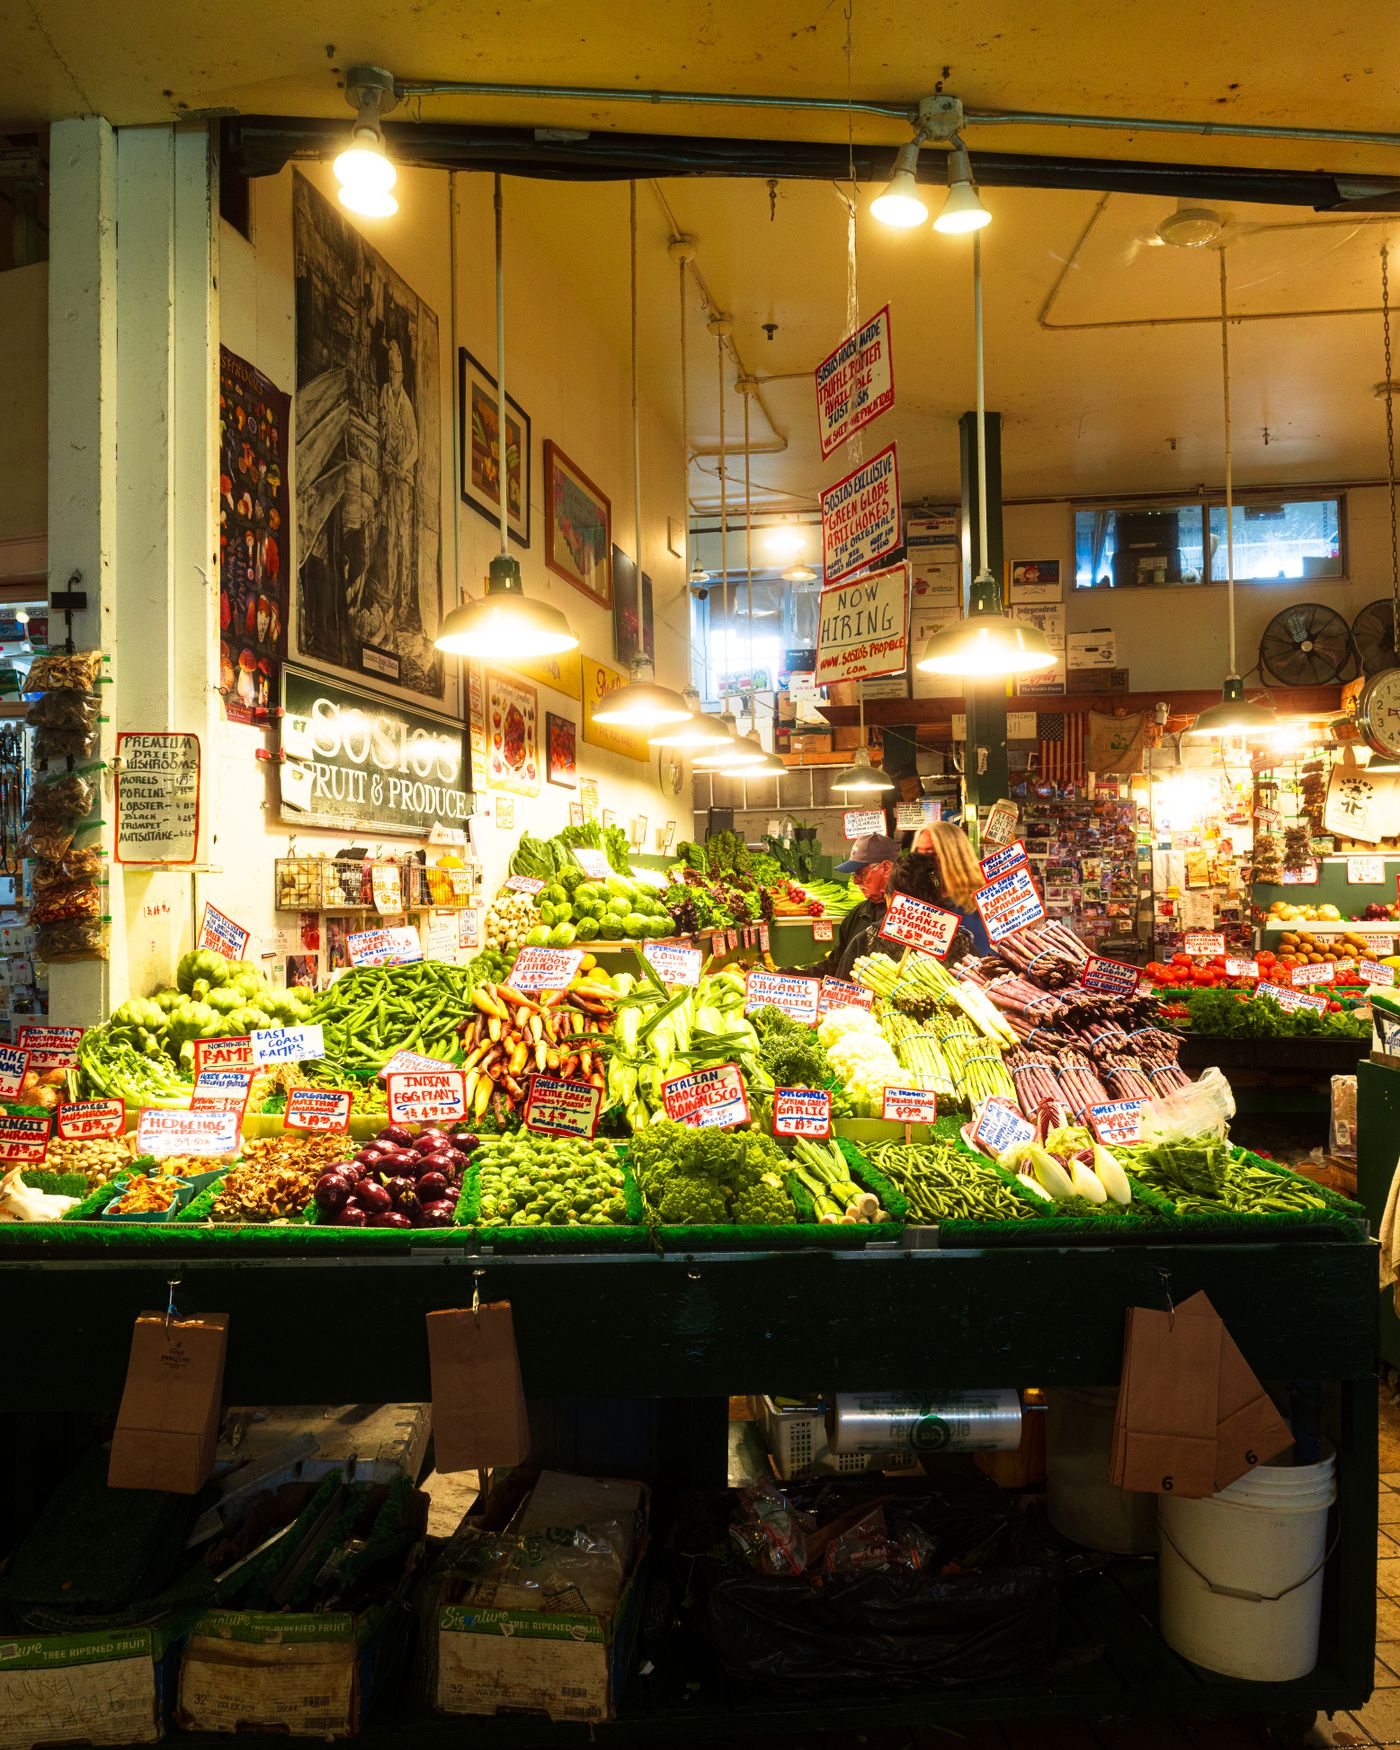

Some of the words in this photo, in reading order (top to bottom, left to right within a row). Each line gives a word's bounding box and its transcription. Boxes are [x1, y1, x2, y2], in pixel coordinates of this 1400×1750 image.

[819, 366, 848, 406] TRUFFLE
[825, 368, 873, 418] AVAILBLE
[828, 400, 849, 429] JUST
[824, 480, 853, 516] SOSIO'S
[854, 453, 892, 494] EXCLUSIVE
[861, 477, 889, 511] GLOBE
[827, 498, 890, 552] ARTICHOKES
[833, 541, 848, 559] THE
[838, 581, 879, 612] NOW
[1022, 586, 1046, 596] 2024
[821, 602, 894, 644] HIRING
[1386, 686, 1391, 696] 1
[1376, 700, 1384, 710] 2
[1377, 718, 1384, 728] 3
[124, 735, 192, 749] PREMIUM
[312, 697, 459, 784] SOSIO'S
[1388, 732, 1395, 743] 4
[131, 749, 179, 761] DRIED
[120, 775, 159, 785] MORELS
[120, 788, 166, 799] PORCINI
[371, 773, 383, 806] &
[387, 777, 467, 819] PRODUCE
[120, 801, 164, 812] LOBSTER
[124, 813, 156, 821] BLACK
[120, 822, 162, 831] TRUMPET
[119, 830, 174, 843] MATSUTAKE
[976, 885, 997, 901] LOCAL
[998, 872, 1019, 889] SWEET
[904, 898, 920, 908] NEW
[984, 889, 1032, 922] ASPARAGUS
[900, 903, 932, 919] LOCAL
[890, 906, 947, 932] ORGANIC
[889, 915, 944, 940] ASPARAGUS
[515, 962, 568, 973] CARROTS
[519, 956, 570, 966] RAINBOW
[749, 980, 812, 995] ORGANIC
[831, 985, 860, 997] JUMBO
[749, 993, 813, 1008] BROCCOLINI
[820, 990, 871, 1009] CAULIFLOWER
[256, 1028, 286, 1041] EAST
[268, 1034, 305, 1048] COAST
[207, 1040, 251, 1050] NORTHWEST
[258, 1043, 304, 1059] RAMPS
[0, 1048, 27, 1064] AKE
[202, 1047, 253, 1065] RAMP
[0, 1062, 24, 1075] OMS
[403, 1075, 450, 1088] INDIAN
[666, 1070, 719, 1095] ITALIAN
[293, 1091, 345, 1102] ORGANIC
[564, 1091, 592, 1103] GREEN
[667, 1077, 729, 1107] BROCCOLI
[779, 1090, 828, 1100] ORGANIC
[667, 1087, 738, 1120] ROMANESCO
[61, 1108, 119, 1122] MUSHROOMS
[778, 1105, 826, 1117] GARLIC
[0, 1118, 44, 1132] INGII
[1094, 1112, 1126, 1126] SUGAR
[0, 1129, 48, 1141] SHROOMS
[1245, 1449, 1258, 1465] 6
[1161, 1475, 1174, 1491] 6
[440, 1606, 510, 1631] Sigature
[532, 1621, 572, 1632] RIPENED
[318, 1623, 347, 1633] FRUIT
[43, 1649, 67, 1660] TREE
[69, 1643, 114, 1658] RIPENED
[116, 1638, 147, 1651] FRUIT
[450, 1683, 464, 1694] 32
[194, 1693, 208, 1706] 32
